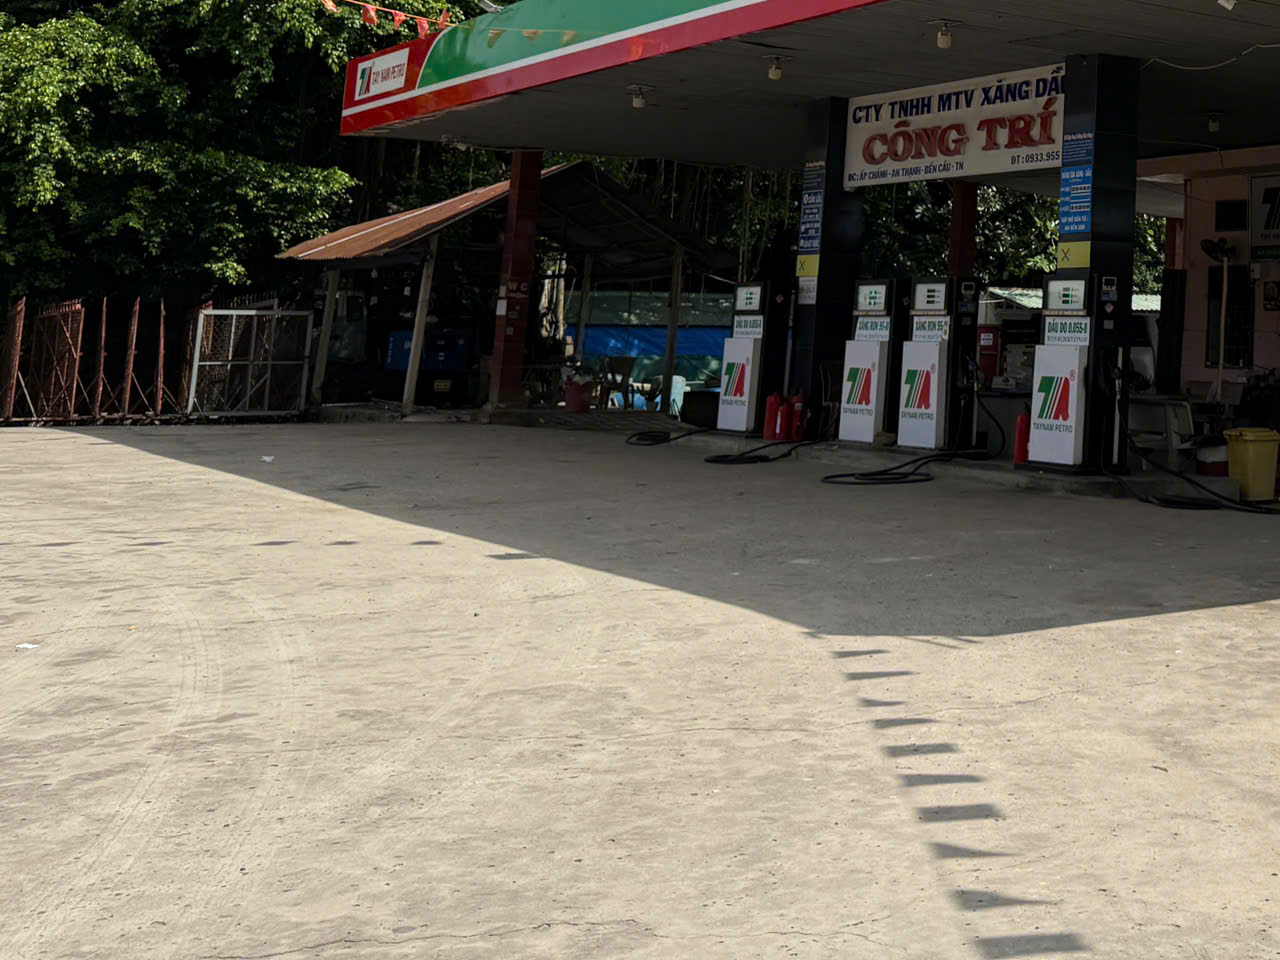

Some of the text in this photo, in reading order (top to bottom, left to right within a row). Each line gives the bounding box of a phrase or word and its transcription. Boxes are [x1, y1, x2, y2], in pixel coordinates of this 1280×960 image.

[852, 103, 884, 124] CTY
[888, 95, 932, 119] TNHH
[937, 88, 978, 112] MTV
[980, 79, 1033, 107] XĂNG
[862, 120, 969, 165] CÔNG
[976, 96, 1058, 151] TRÍ
[1055, 422, 1073, 433] PETRO
